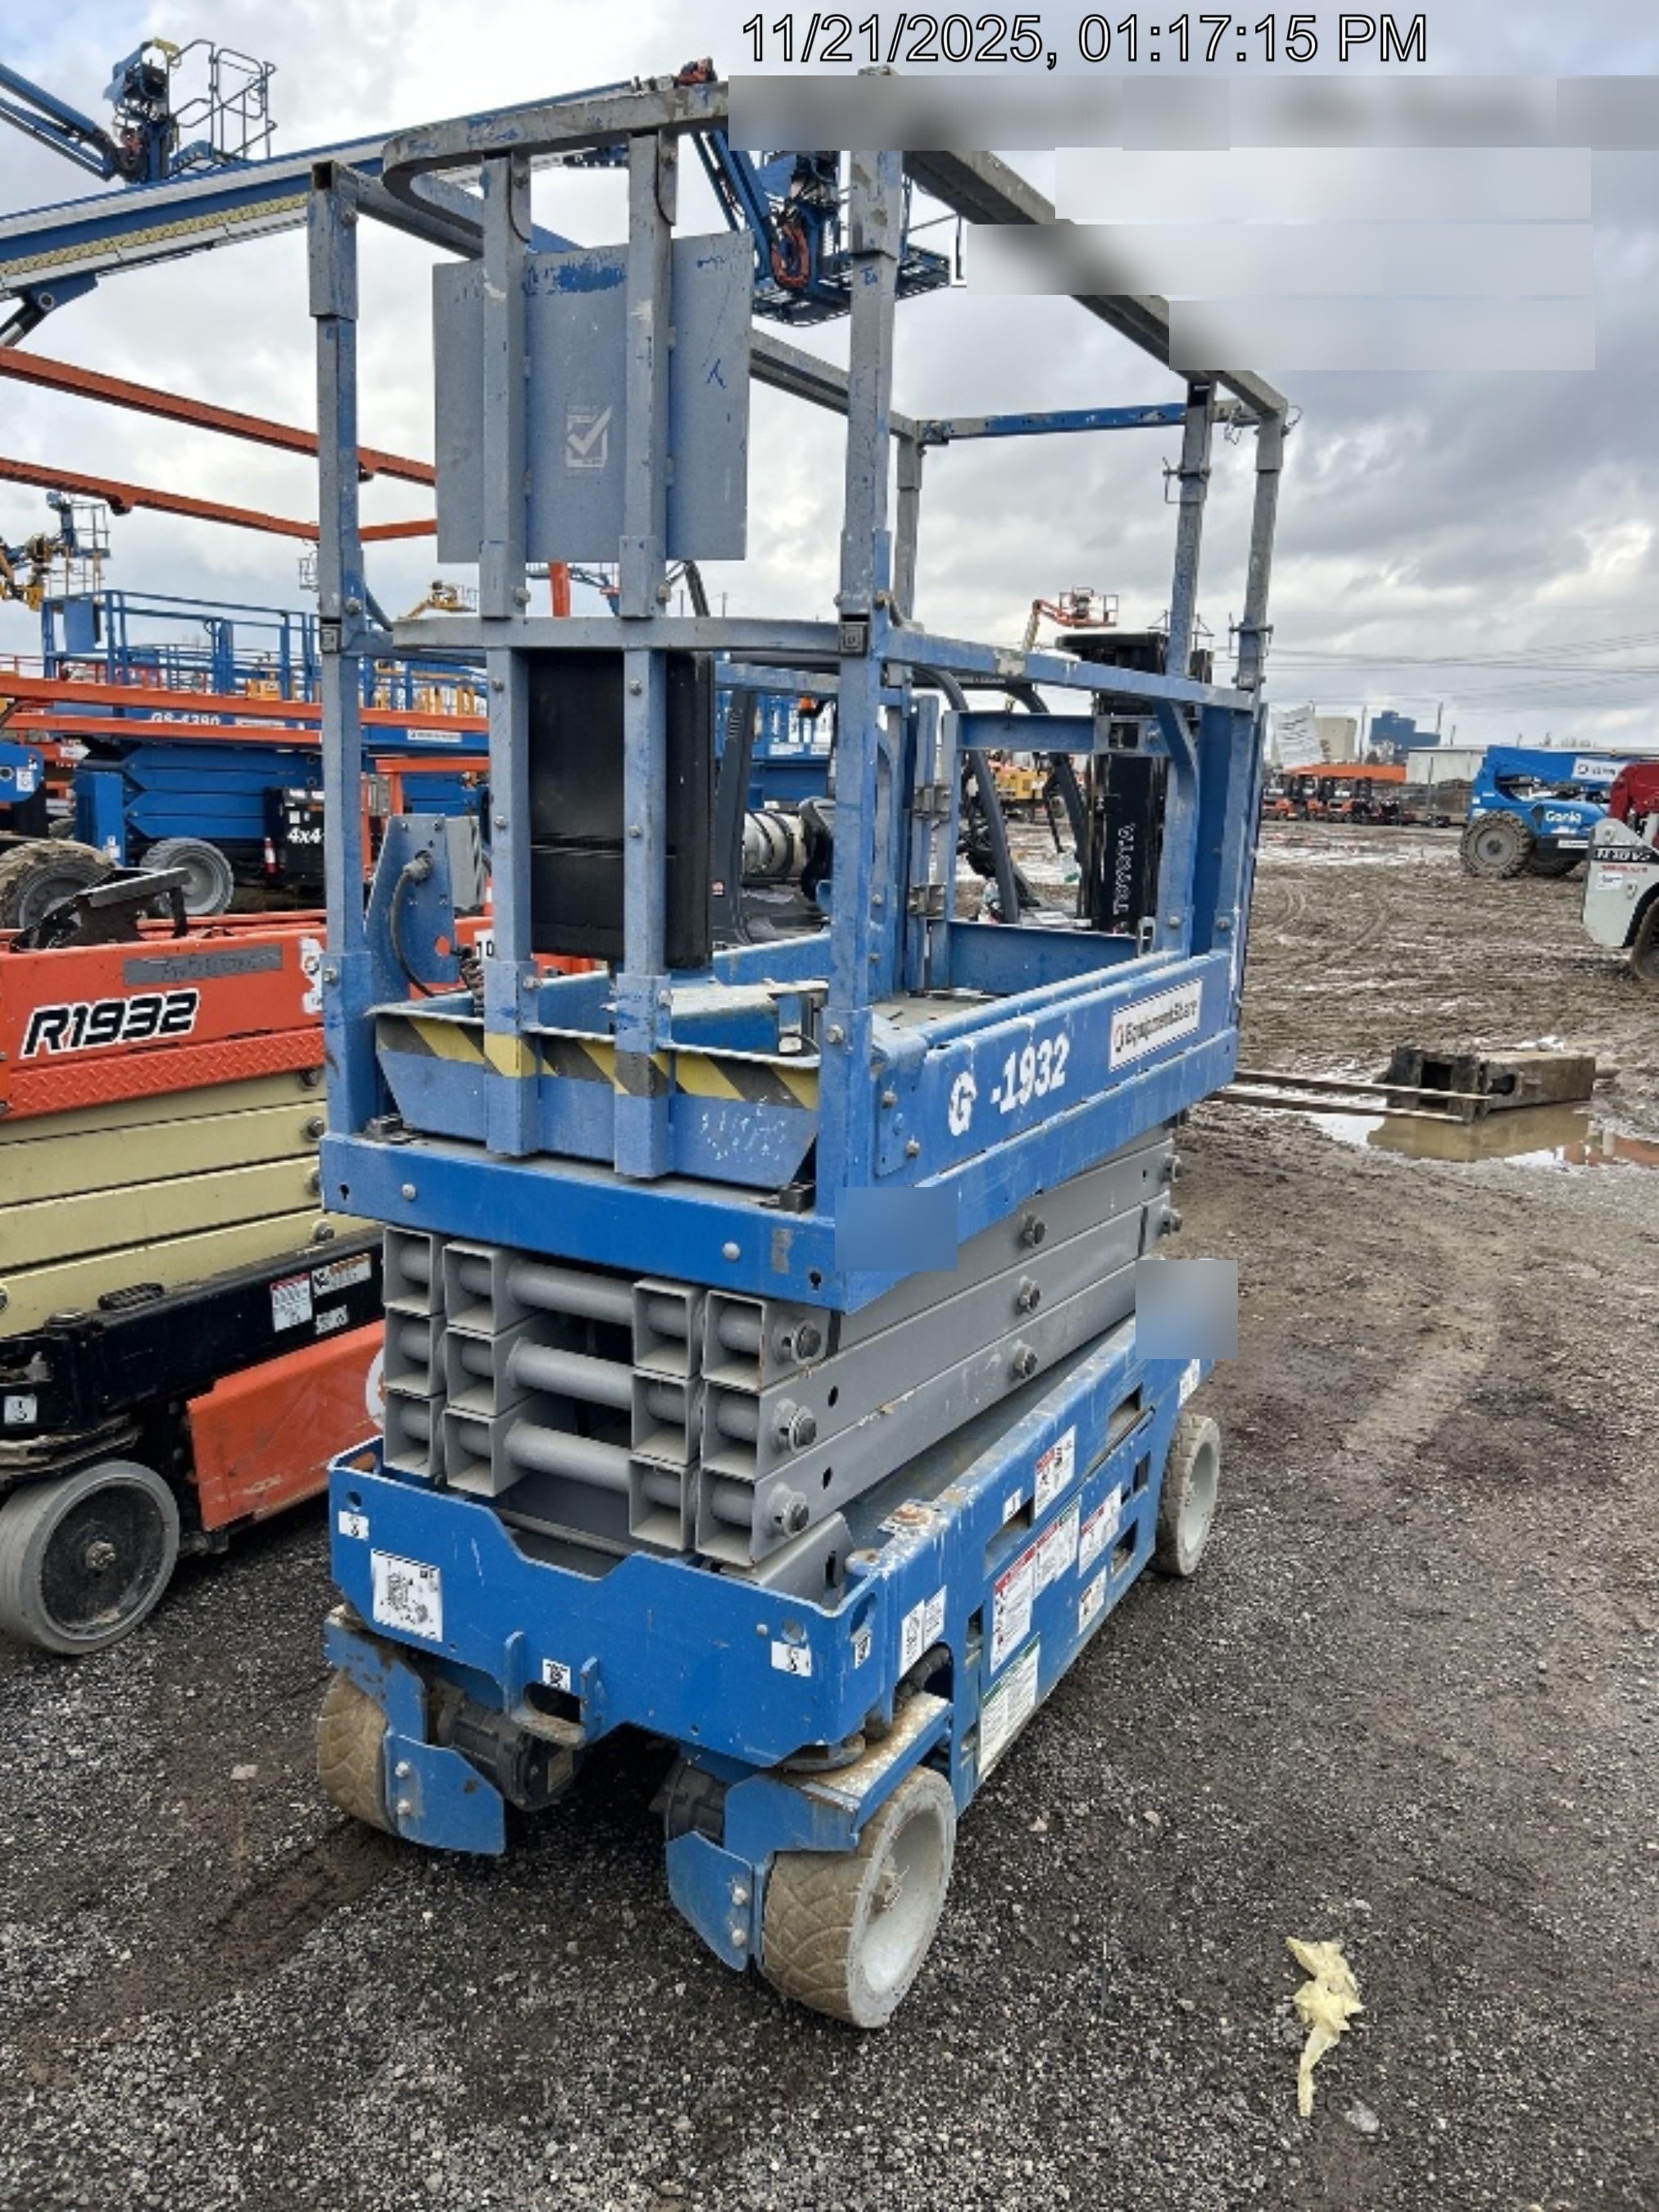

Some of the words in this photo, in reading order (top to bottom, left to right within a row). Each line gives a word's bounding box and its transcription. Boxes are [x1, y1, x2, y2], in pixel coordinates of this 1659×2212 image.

[288, 826, 323, 845] 4x4
[1546, 809, 1583, 825] Genie
[1112, 822, 1137, 915] TOYOTA
[20, 989, 200, 1058] R1932
